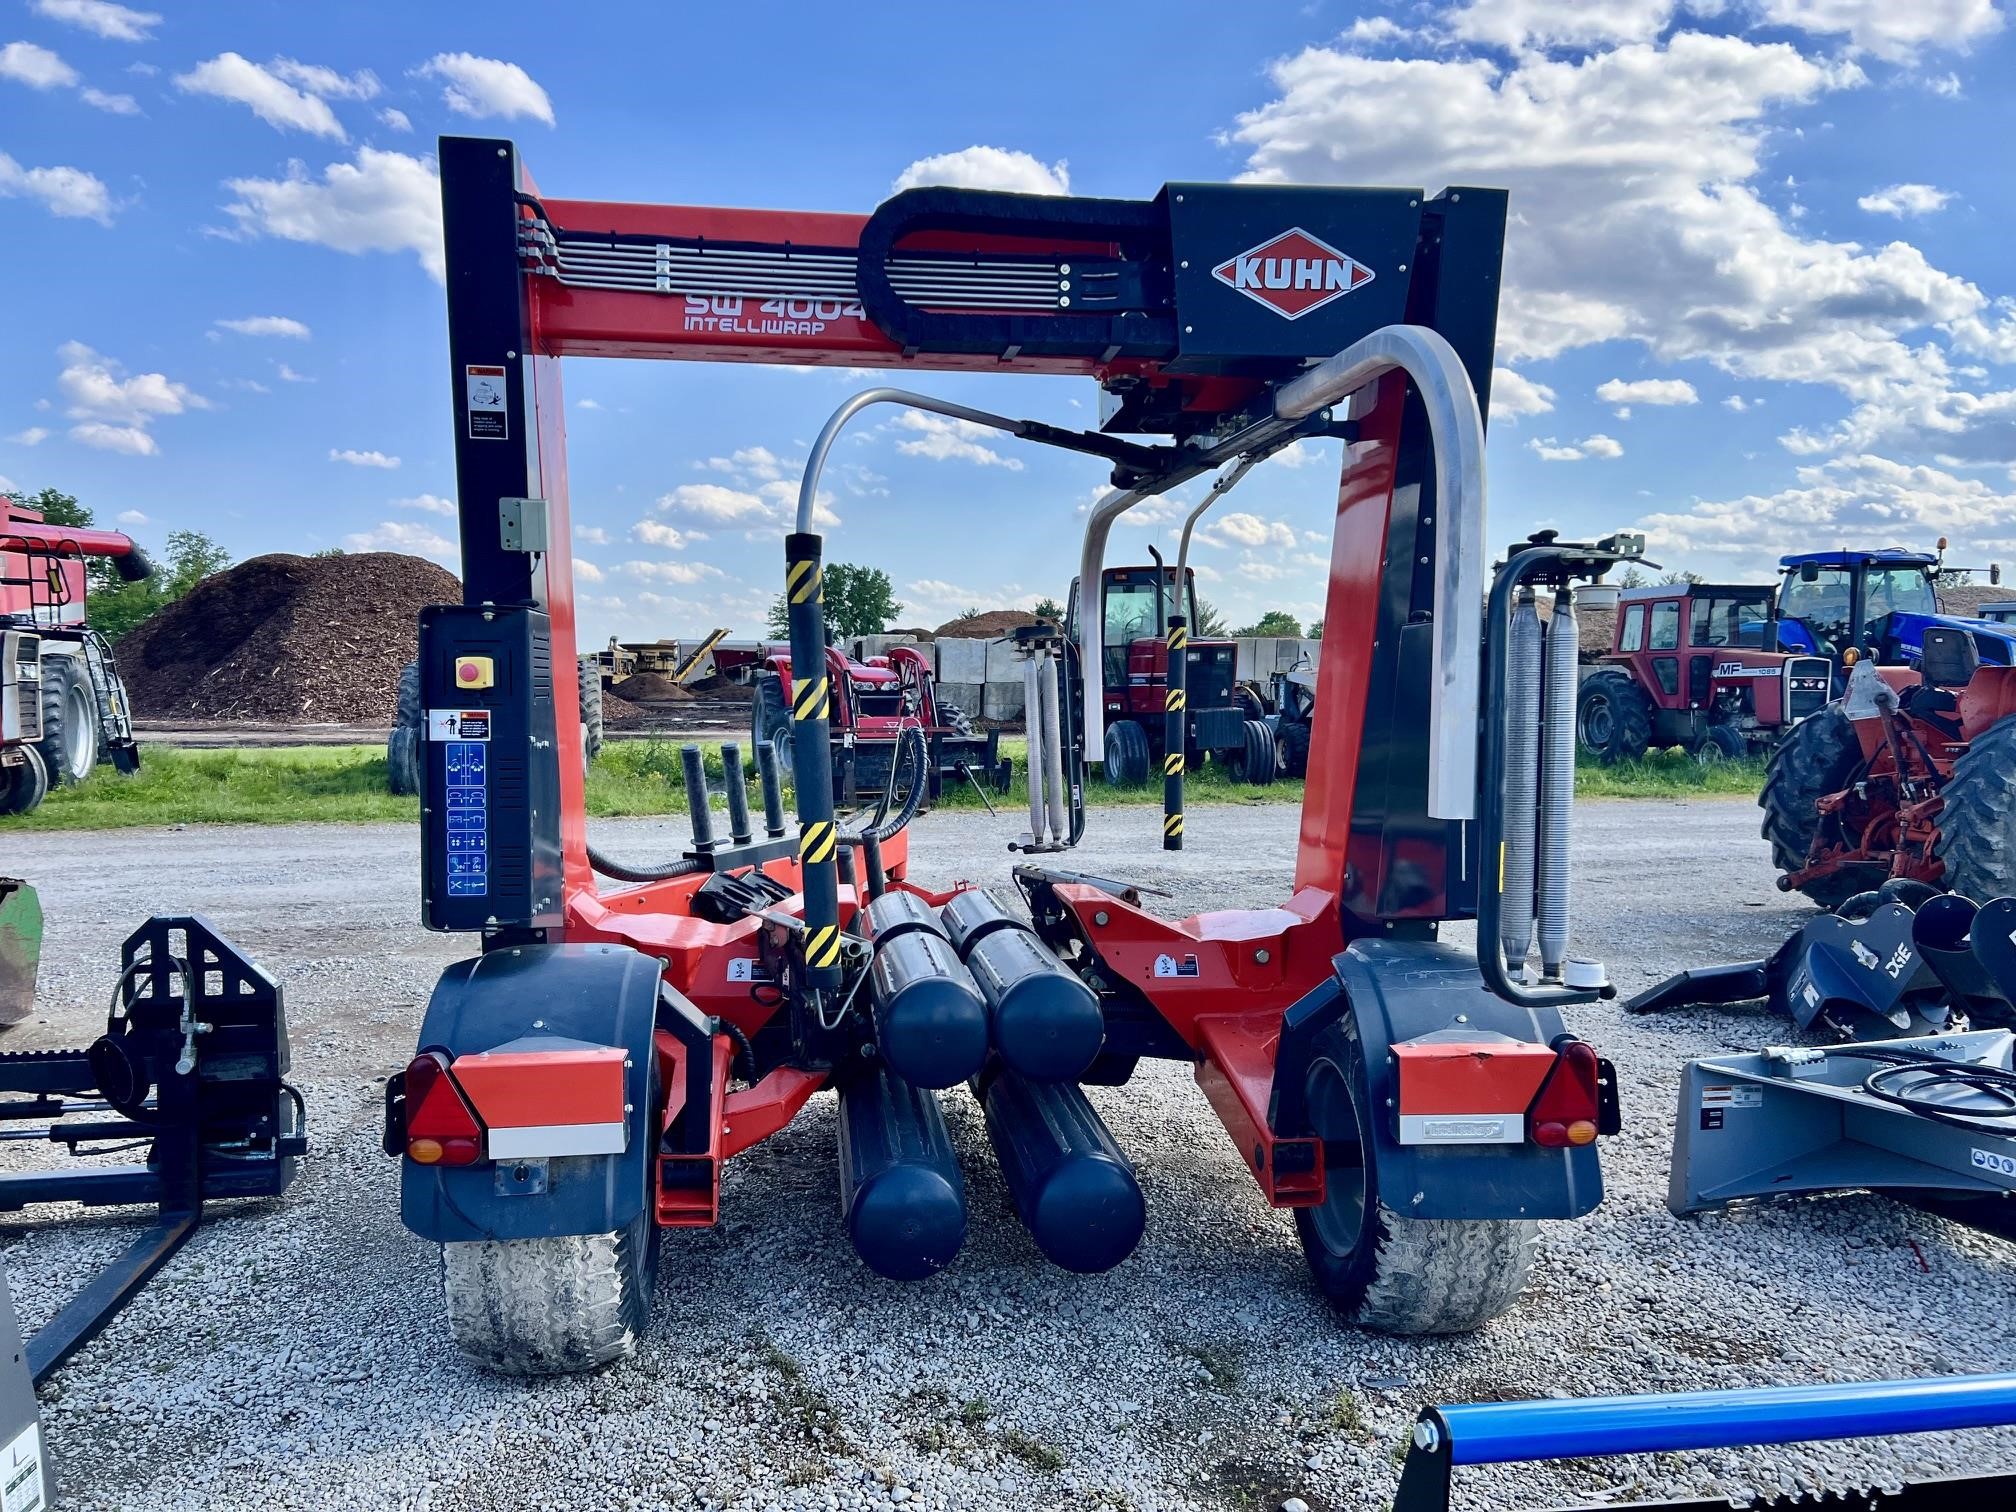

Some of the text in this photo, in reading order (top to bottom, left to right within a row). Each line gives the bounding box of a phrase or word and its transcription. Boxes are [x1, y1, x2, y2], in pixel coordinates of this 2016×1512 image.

[1234, 257, 1353, 290] KUHN
[684, 293, 867, 321] SW 4004
[684, 317, 826, 336] INTELLIWRAP
[1719, 664, 1741, 676] MF
